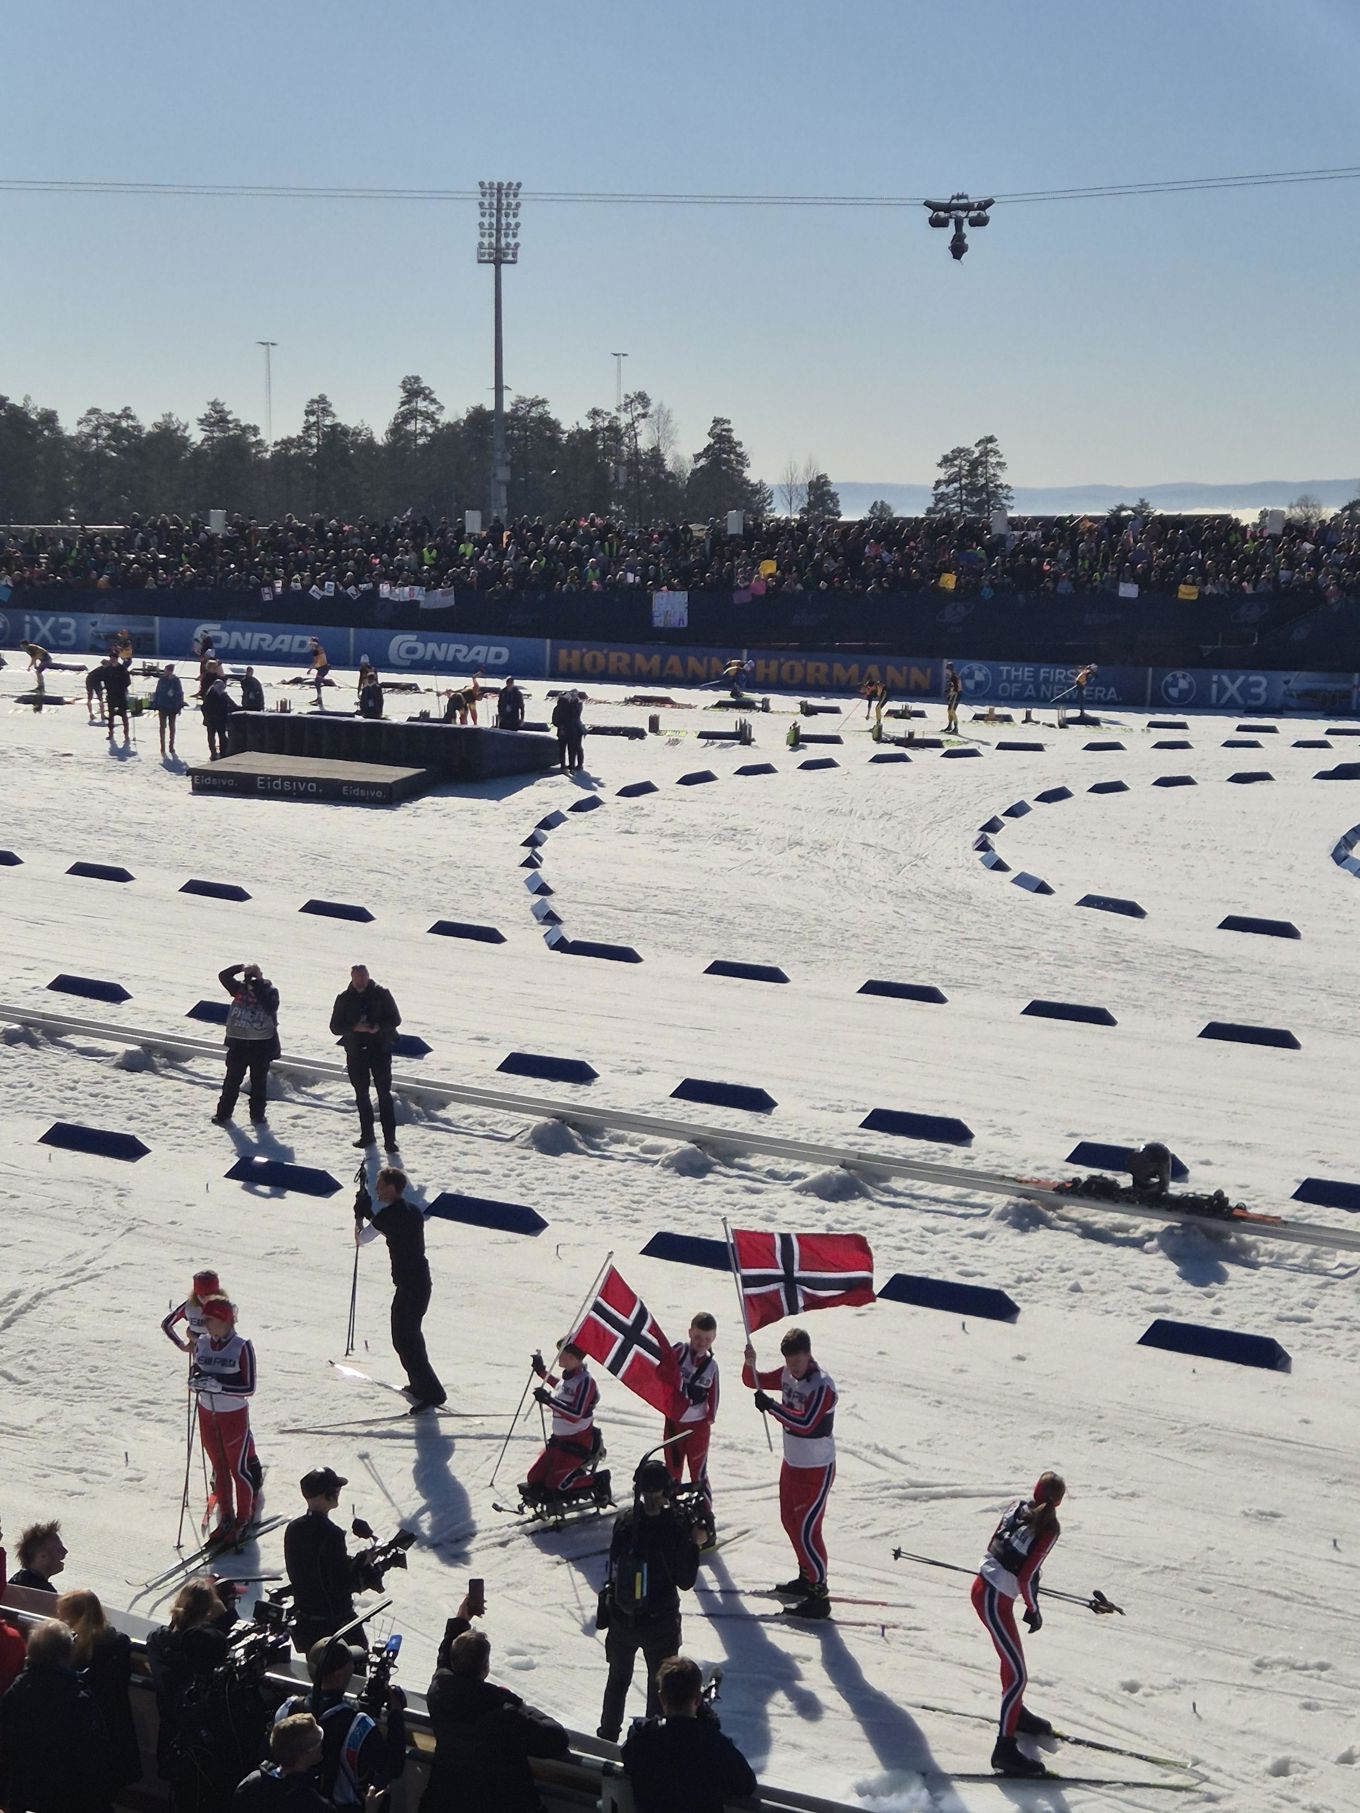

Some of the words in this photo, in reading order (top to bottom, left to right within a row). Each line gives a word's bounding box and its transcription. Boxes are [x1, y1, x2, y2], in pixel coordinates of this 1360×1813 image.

[23, 615, 77, 647] iX3
[387, 634, 510, 666] CONRAD
[998, 683, 1020, 697] OF
[1025, 684, 1036, 697] A
[1000, 666, 1035, 682] THE
[1040, 668, 1084, 684] FIRS
[1211, 674, 1268, 705] iX3
